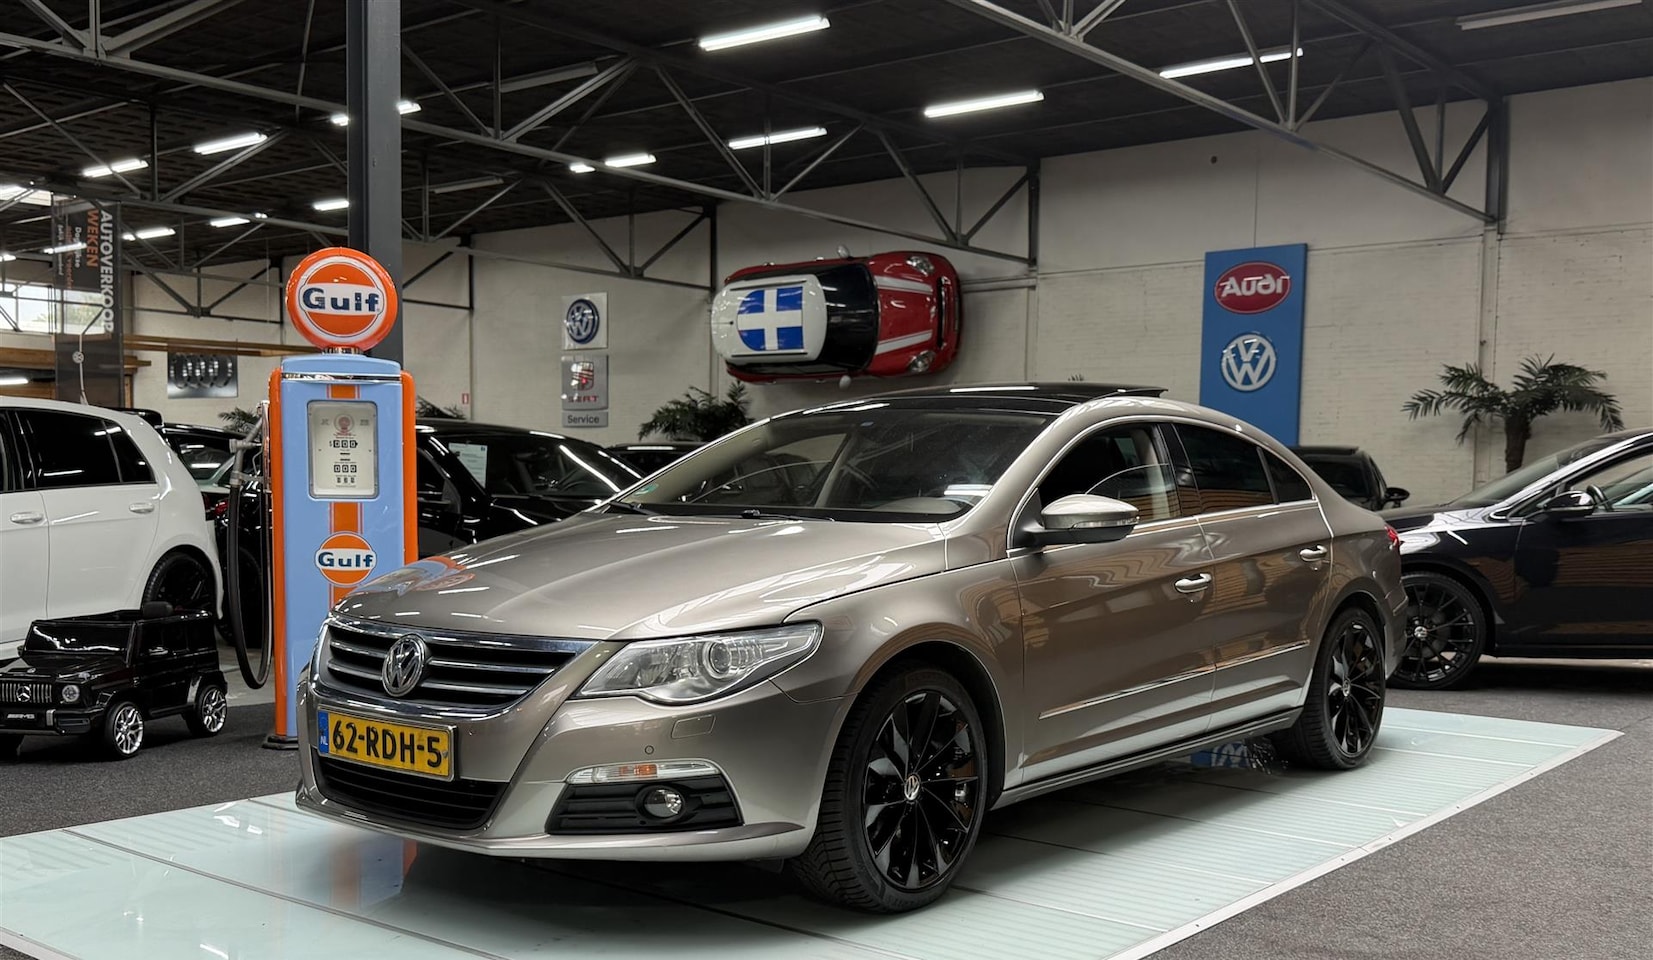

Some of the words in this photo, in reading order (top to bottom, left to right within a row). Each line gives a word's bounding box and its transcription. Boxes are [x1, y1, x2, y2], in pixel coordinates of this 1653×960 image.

[86, 208, 99, 268] WEKEN
[100, 210, 114, 333] AUTOVERKOOP
[303, 287, 379, 312] Gulf
[567, 414, 600, 424] Service
[318, 551, 373, 567] Gulf
[320, 735, 328, 745] NL
[332, 720, 442, 768] 62-RDH-5
